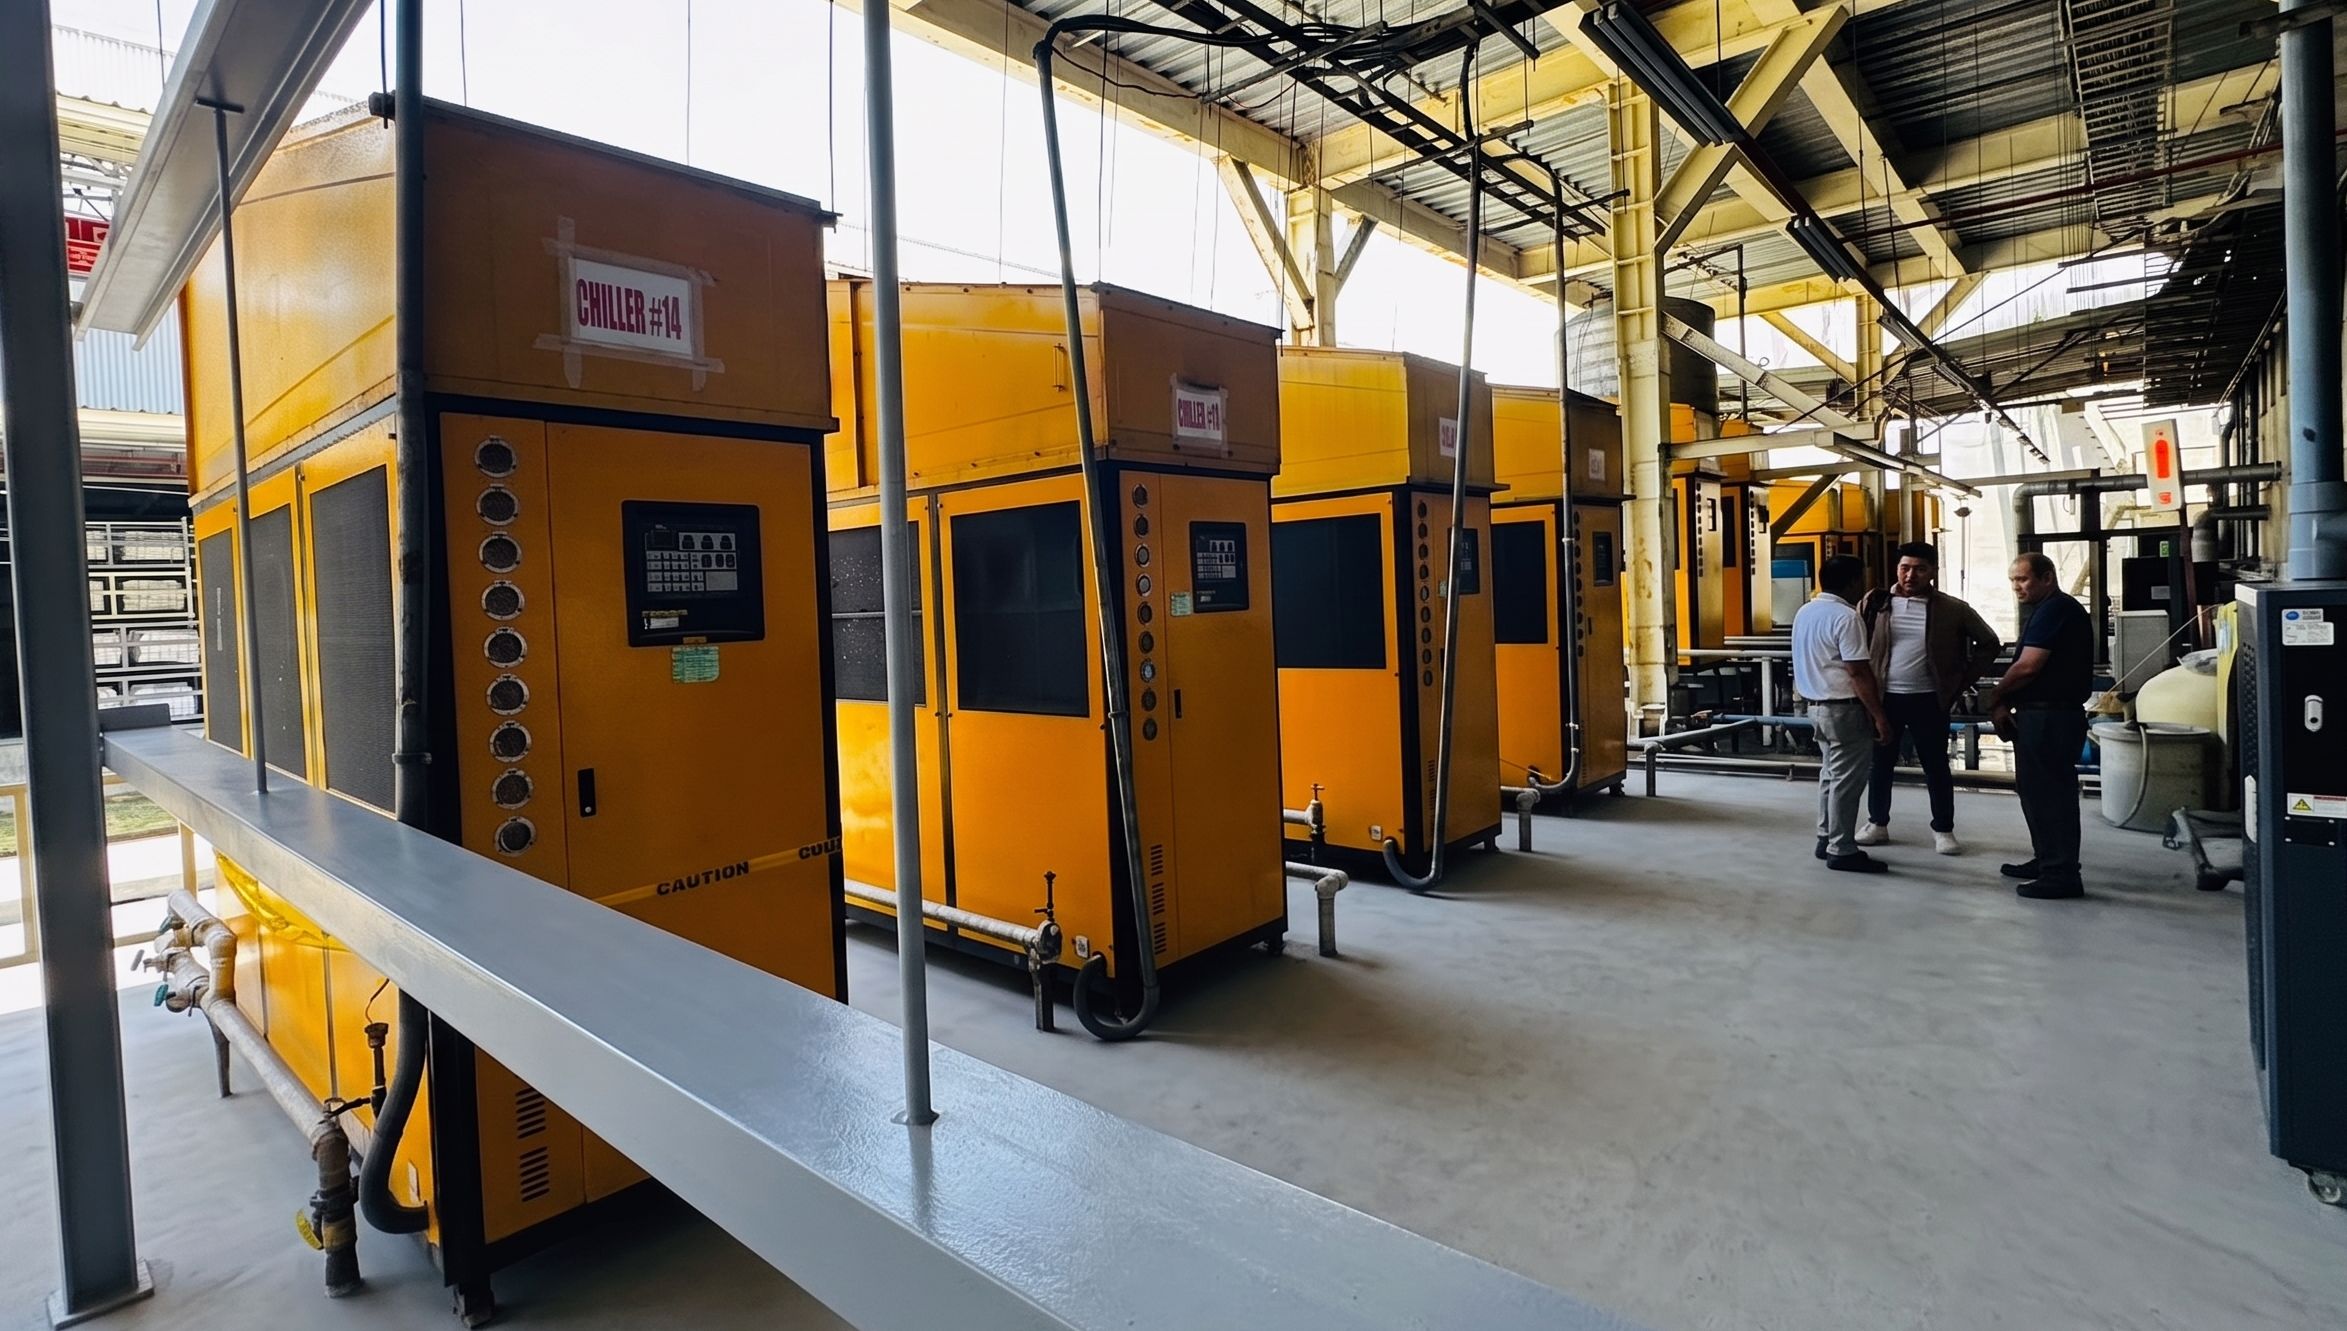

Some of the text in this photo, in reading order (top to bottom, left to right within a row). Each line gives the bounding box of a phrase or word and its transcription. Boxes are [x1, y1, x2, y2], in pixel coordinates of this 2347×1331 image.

[576, 278, 682, 340] CHILLER #14
[656, 861, 750, 896] CAUTION
